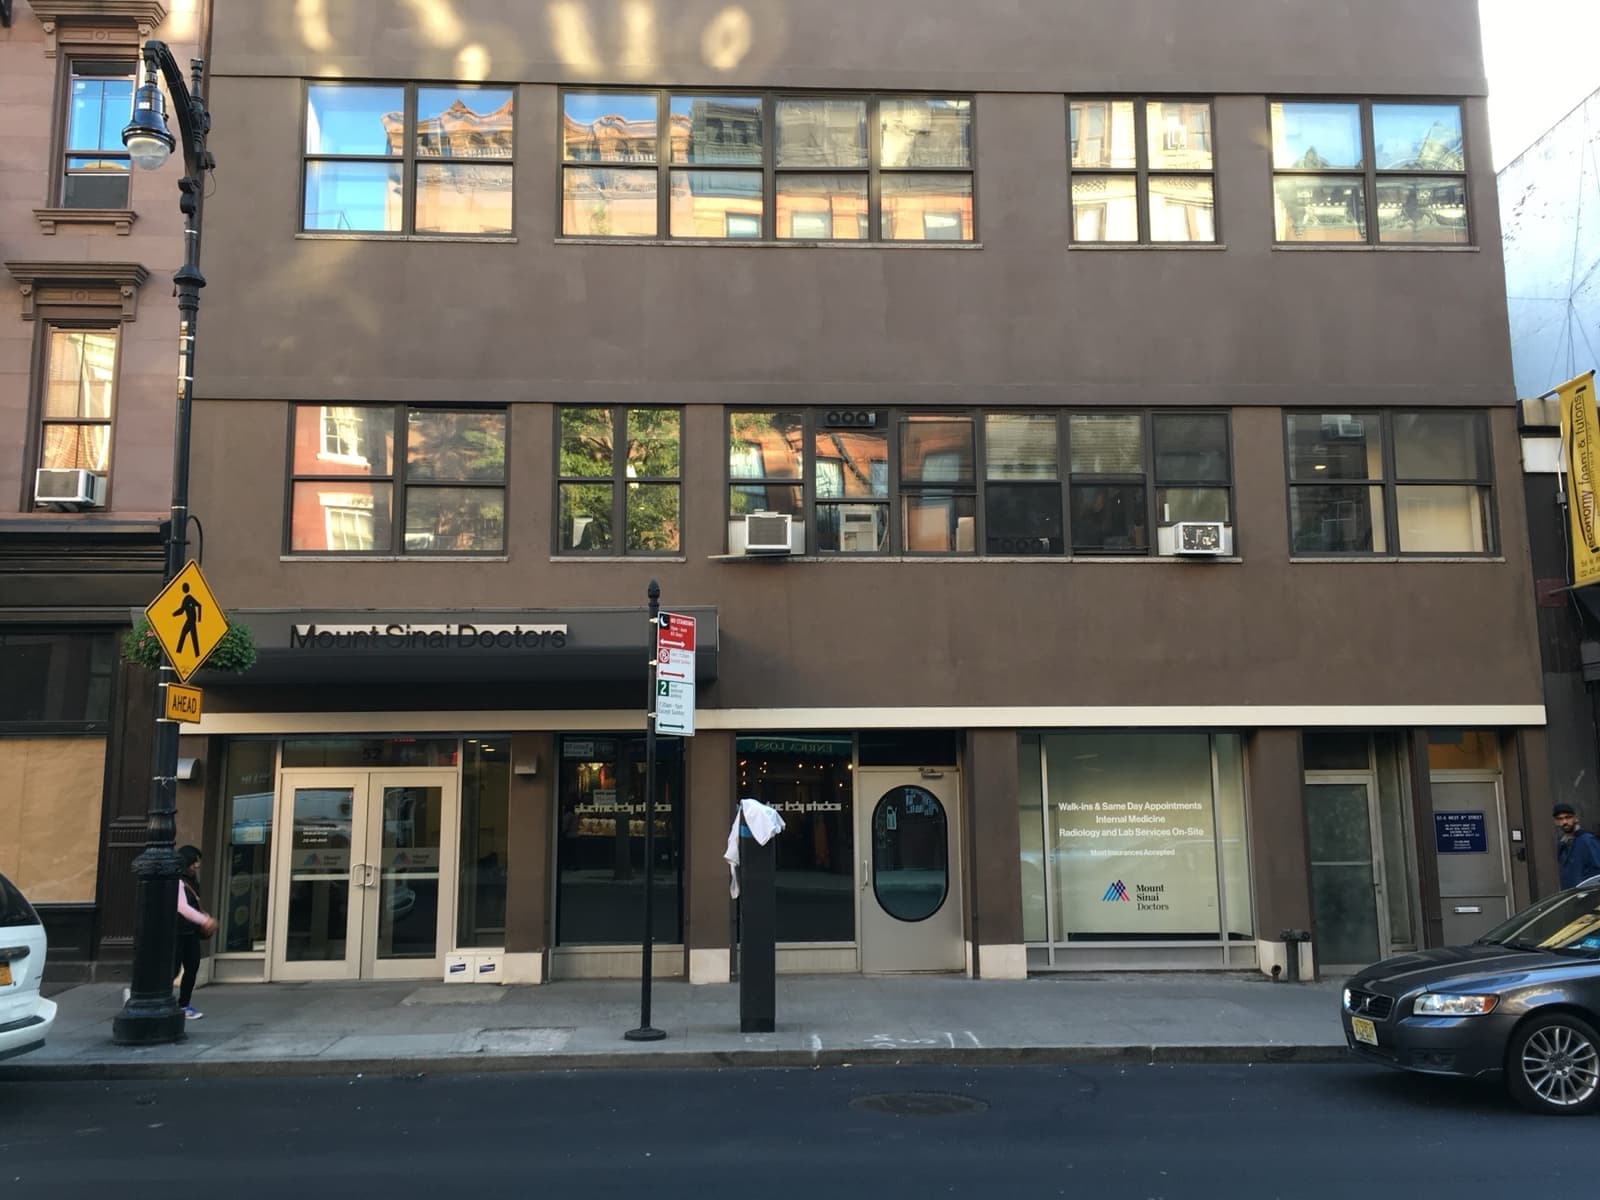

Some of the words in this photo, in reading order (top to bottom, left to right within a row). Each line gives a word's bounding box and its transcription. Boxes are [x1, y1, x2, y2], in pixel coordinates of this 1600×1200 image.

[1574, 394, 1585, 435] futons
[1582, 489, 1595, 549] economy
[290, 624, 379, 648] Mount
[385, 624, 450, 648] Sinai
[457, 624, 567, 648] Doctors
[660, 681, 667, 695] 2
[172, 695, 197, 714] AHEAD
[1058, 802, 1093, 811] Walk-ins
[1094, 802, 1101, 811] &
[1102, 802, 1126, 811] Same
[1127, 802, 1144, 812] Day
[1144, 802, 1202, 812] Appointments
[1095, 815, 1127, 824] Internal
[1128, 815, 1166, 824] Medicine
[1059, 828, 1100, 839] Radiology
[1101, 828, 1118, 837] and
[1118, 828, 1134, 837] Lab
[1135, 828, 1171, 837] Services
[1172, 827, 1204, 836] On-Site
[1136, 884, 1164, 893] Mount
[1136, 892, 1160, 902] Sinai
[1137, 902, 1169, 911] Doctors
